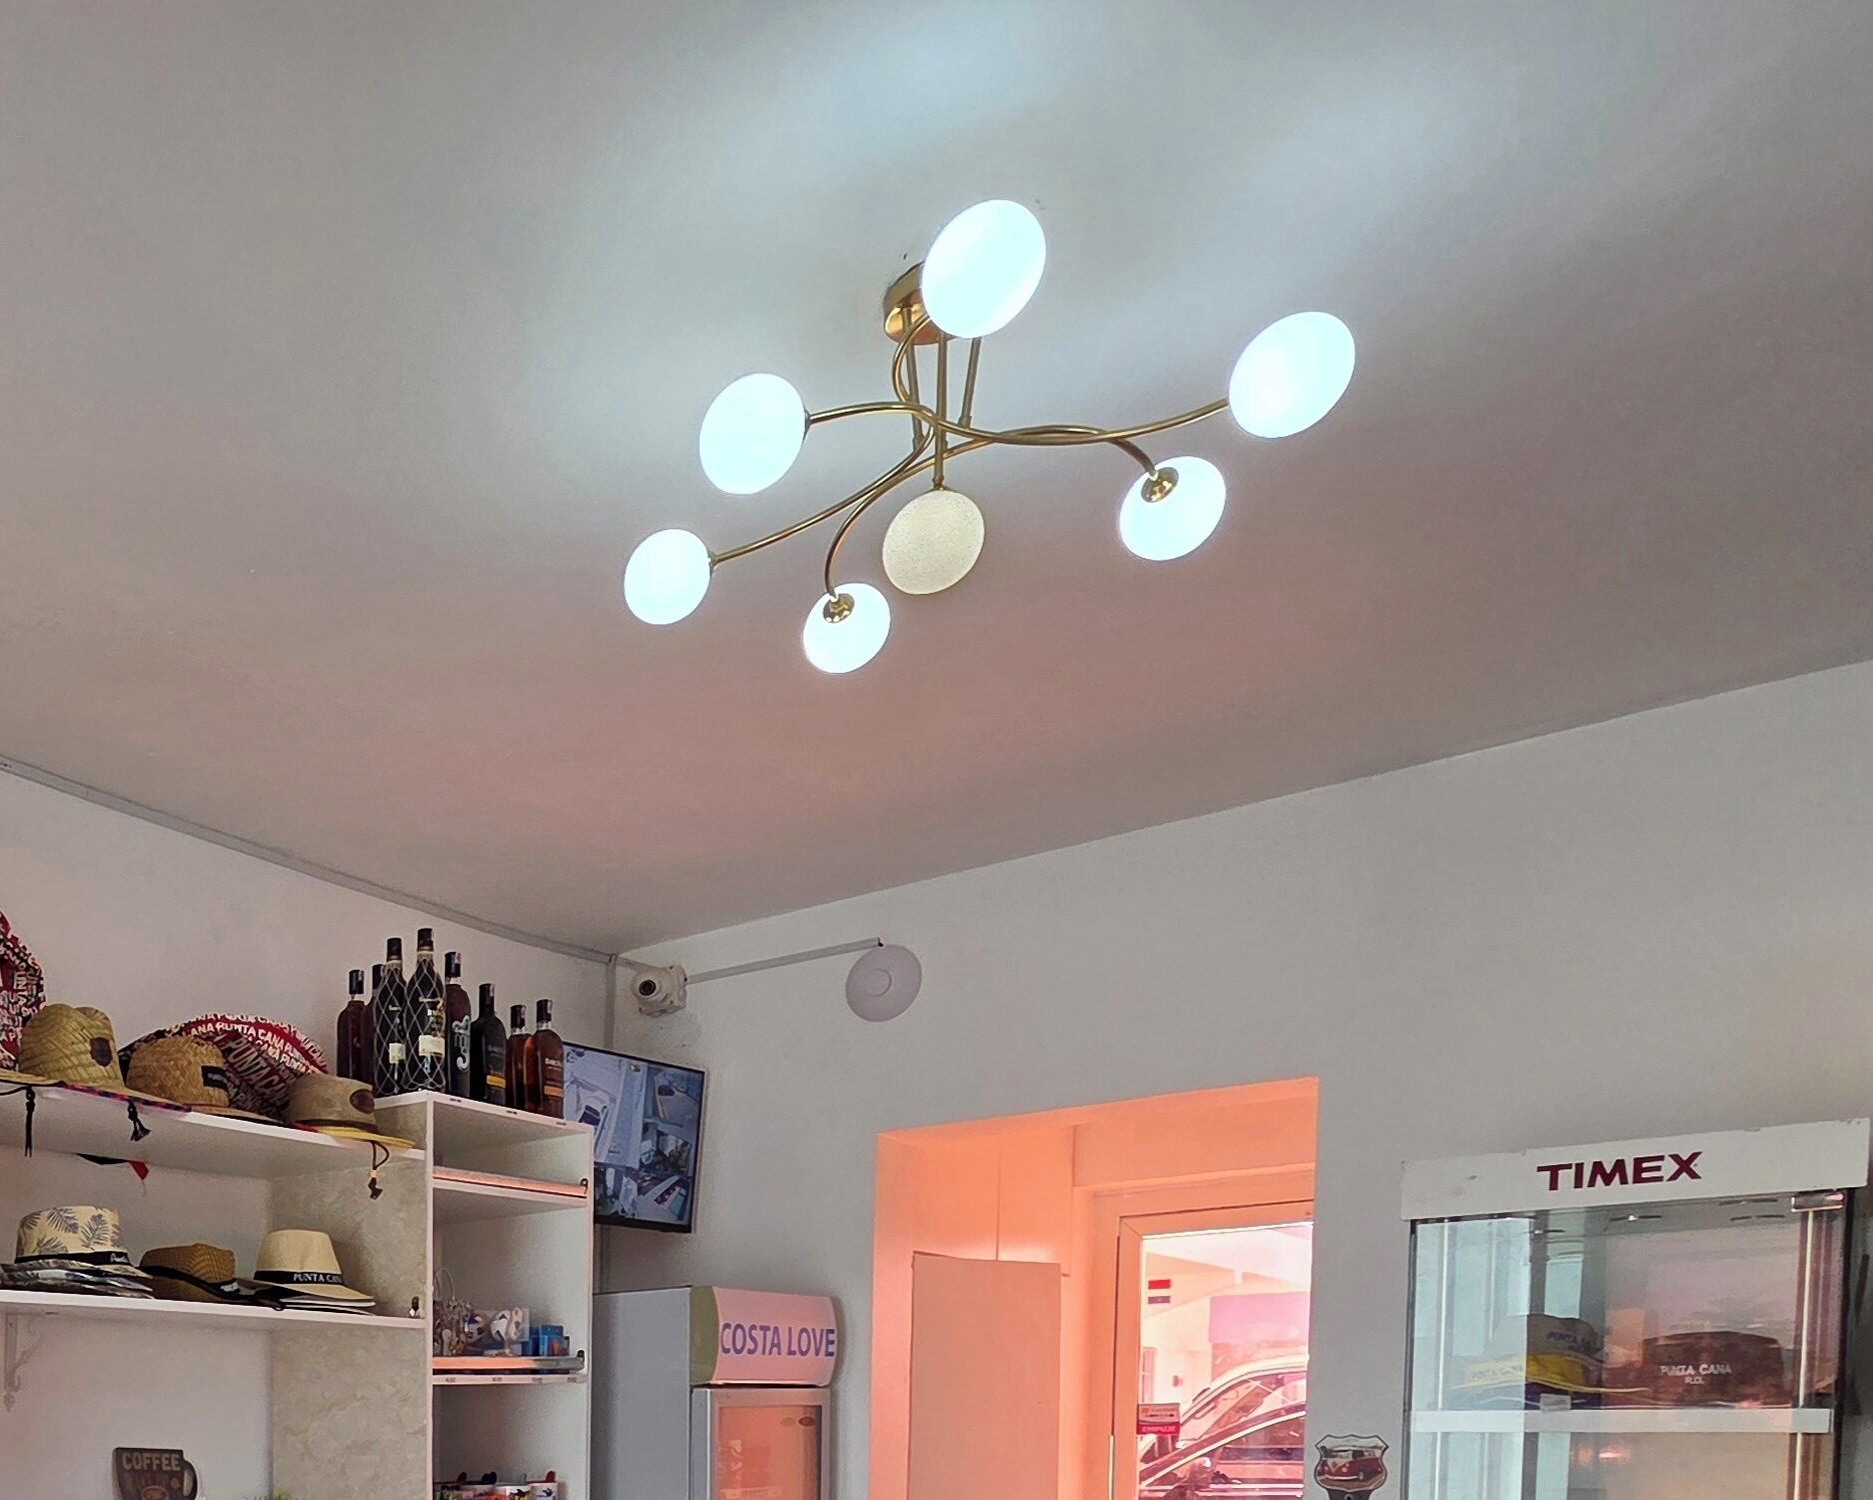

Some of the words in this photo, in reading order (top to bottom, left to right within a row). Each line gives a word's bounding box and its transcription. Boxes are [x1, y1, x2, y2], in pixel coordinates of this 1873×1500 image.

[1536, 1151, 1703, 1192] TIMEX
[293, 1273, 325, 1283] PUNTA
[720, 1322, 782, 1356] COSTA
[786, 1326, 836, 1357] LOVE
[1659, 1364, 1697, 1377] PUNTA
[1698, 1363, 1733, 1376] CANA
[122, 1451, 181, 1471] COFFEE
